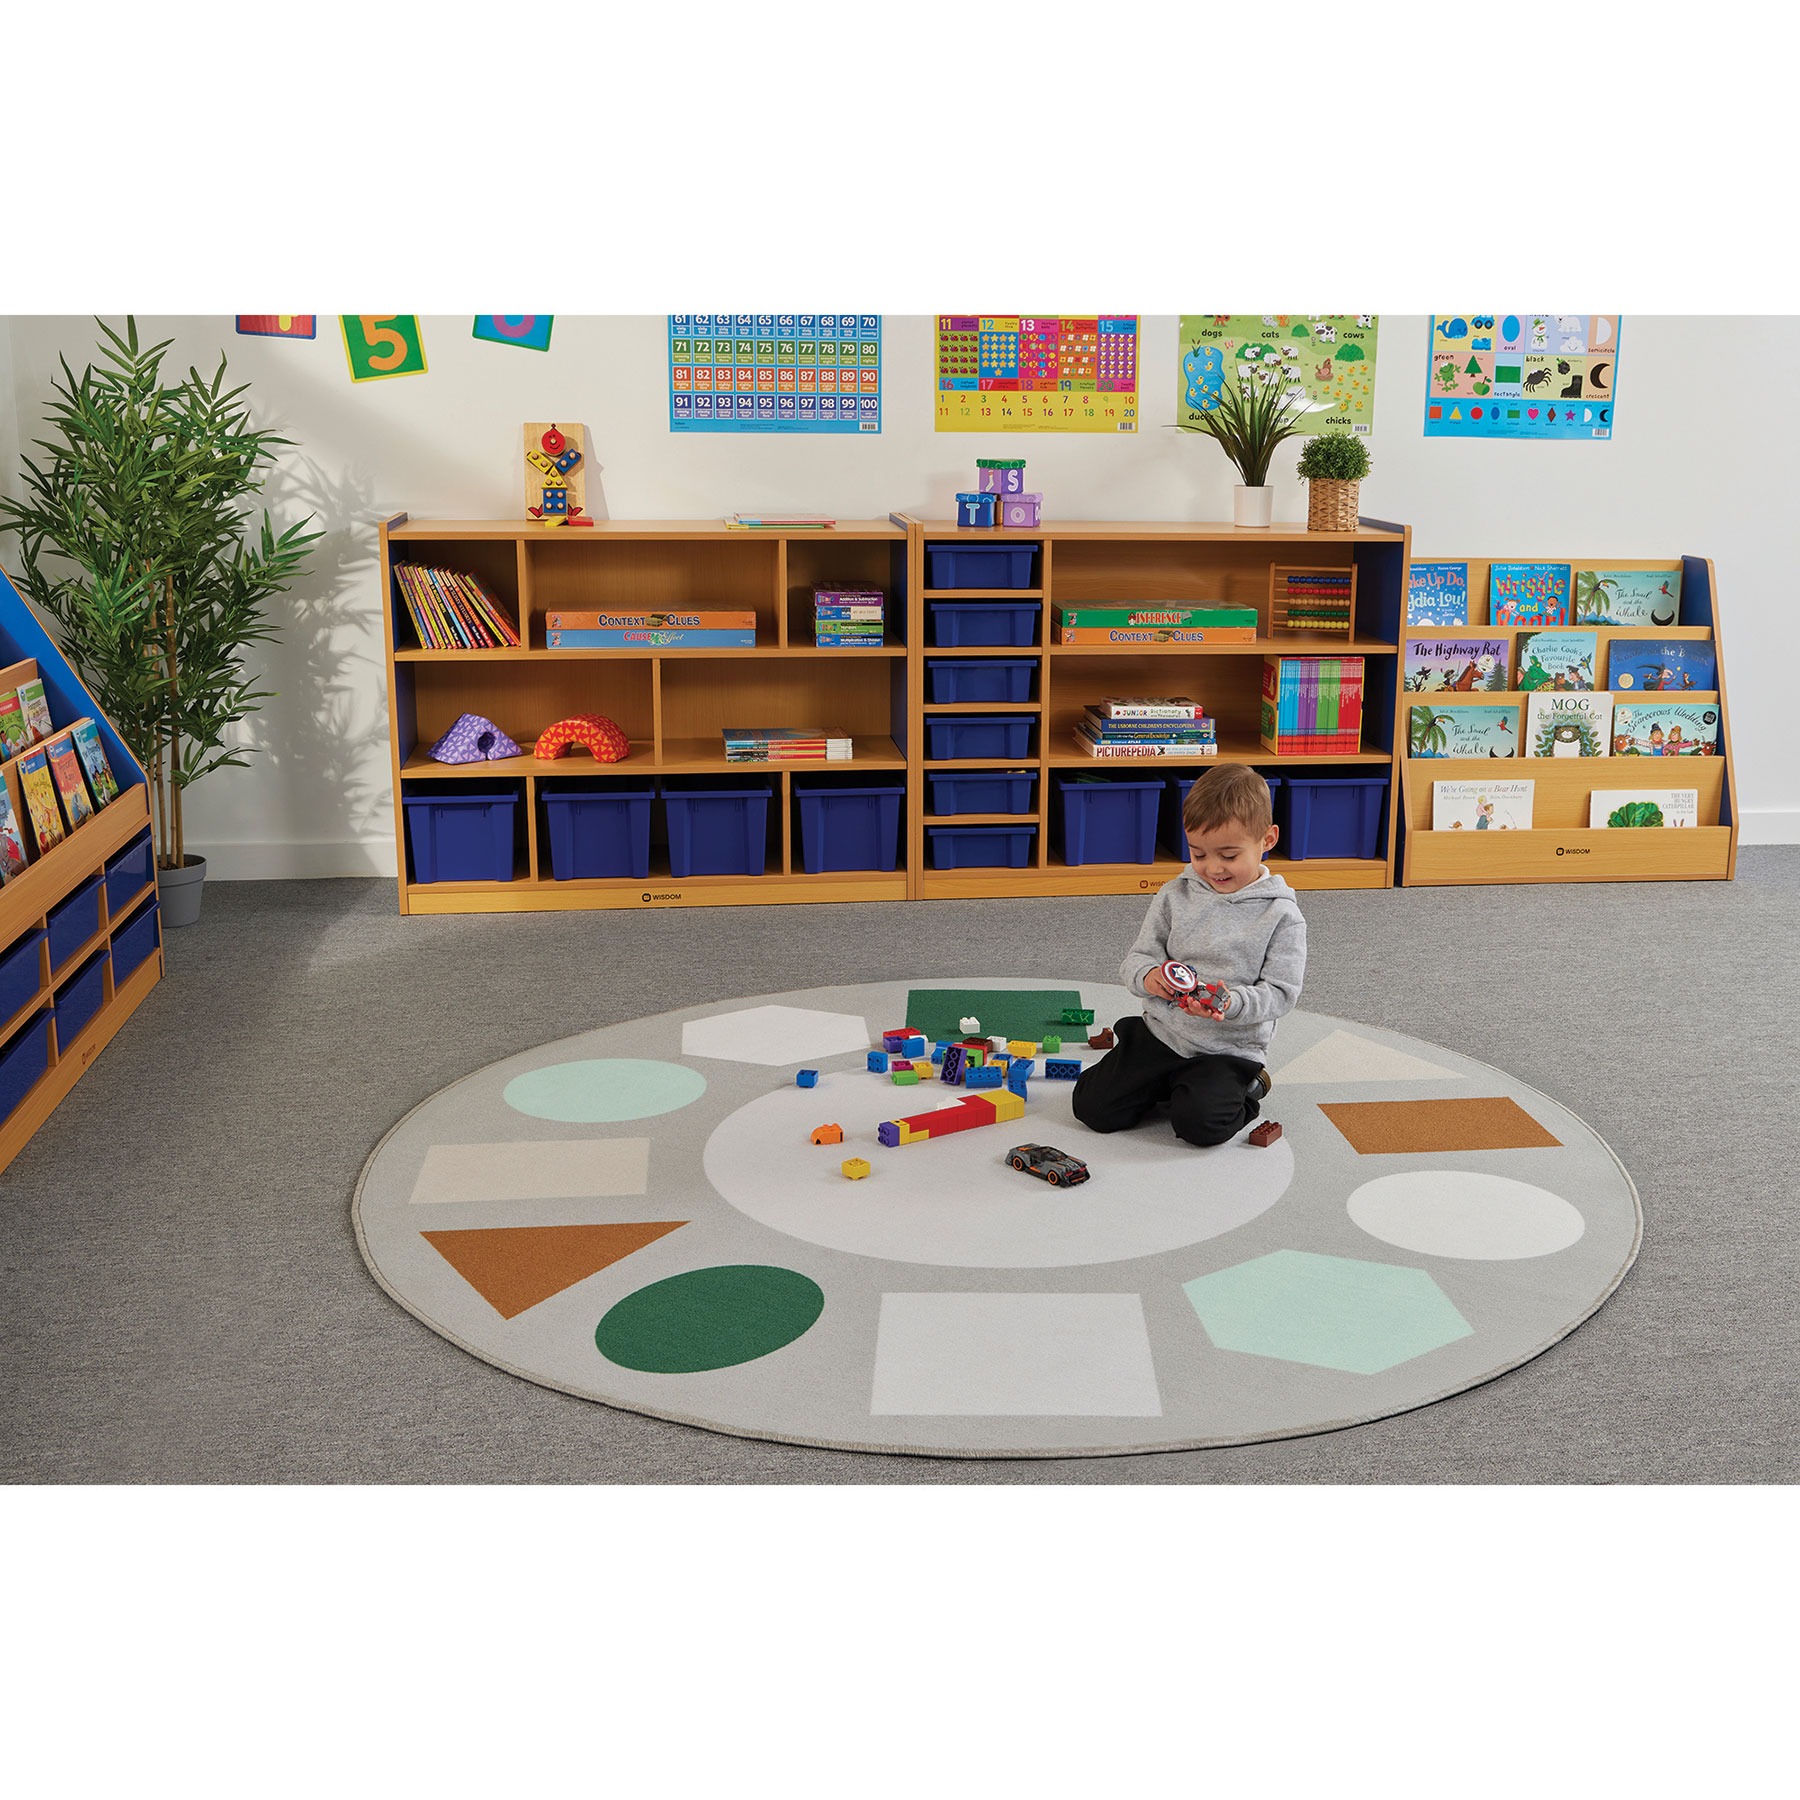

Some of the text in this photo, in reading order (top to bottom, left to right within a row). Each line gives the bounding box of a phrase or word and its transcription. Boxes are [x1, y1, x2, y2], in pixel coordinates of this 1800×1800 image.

[675, 315, 875, 326] 61 62 63 64 65 66 67 68 69 70
[941, 318, 1113, 332] 11 12 13 14 15
[1202, 329, 1222, 338] dogs
[358, 315, 408, 371] 5
[676, 342, 875, 354] 71 72 73 74 75 76 77 78 79 80
[676, 370, 875, 381] 81 82 83 84 85 86 87 88 89 90
[941, 379, 1114, 391] 16 17 18 19 20
[676, 397, 877, 408] 91 92 93 94 95 96 97 98 99 100
[961, 395, 966, 403] 2
[981, 395, 986, 403] 3
[1002, 395, 1007, 403] 4
[1022, 395, 1028, 403] 5
[1042, 396, 1048, 404] 6
[1083, 396, 1088, 404] 8
[1124, 396, 1134, 404] 10
[939, 408, 948, 416] 11
[961, 408, 970, 416] 12
[981, 408, 991, 416] 13
[1002, 408, 1012, 416] 14
[1023, 408, 1032, 416] 15
[1043, 408, 1053, 416] 16
[1064, 408, 1074, 416] 17
[1124, 409, 1135, 417] 20
[1008, 469, 1019, 491] S
[966, 503, 980, 525] T
[1427, 572, 1445, 590] Up
[1496, 573, 1565, 602] Wriggle
[1615, 588, 1653, 600] The Snail
[1408, 591, 1466, 611] ydia Lou!
[1520, 602, 1538, 612] and
[1616, 606, 1648, 617] Whale
[1136, 612, 1181, 624] INFERENCE
[624, 632, 651, 641] CAUSE
[1414, 642, 1501, 660] The Highway Rat
[1532, 645, 1558, 654] Charlie
[1661, 646, 1676, 656] the
[1541, 654, 1575, 663] Favourite
[1551, 698, 1590, 711] MOG
[1552, 712, 1586, 720] Forgetful
[1674, 706, 1706, 733] Wedding
[1452, 724, 1491, 736] The Snail
[1097, 746, 1156, 757] PICTUREPEDIA
[1453, 743, 1486, 754] Whale
[1458, 785, 1478, 794] Going
